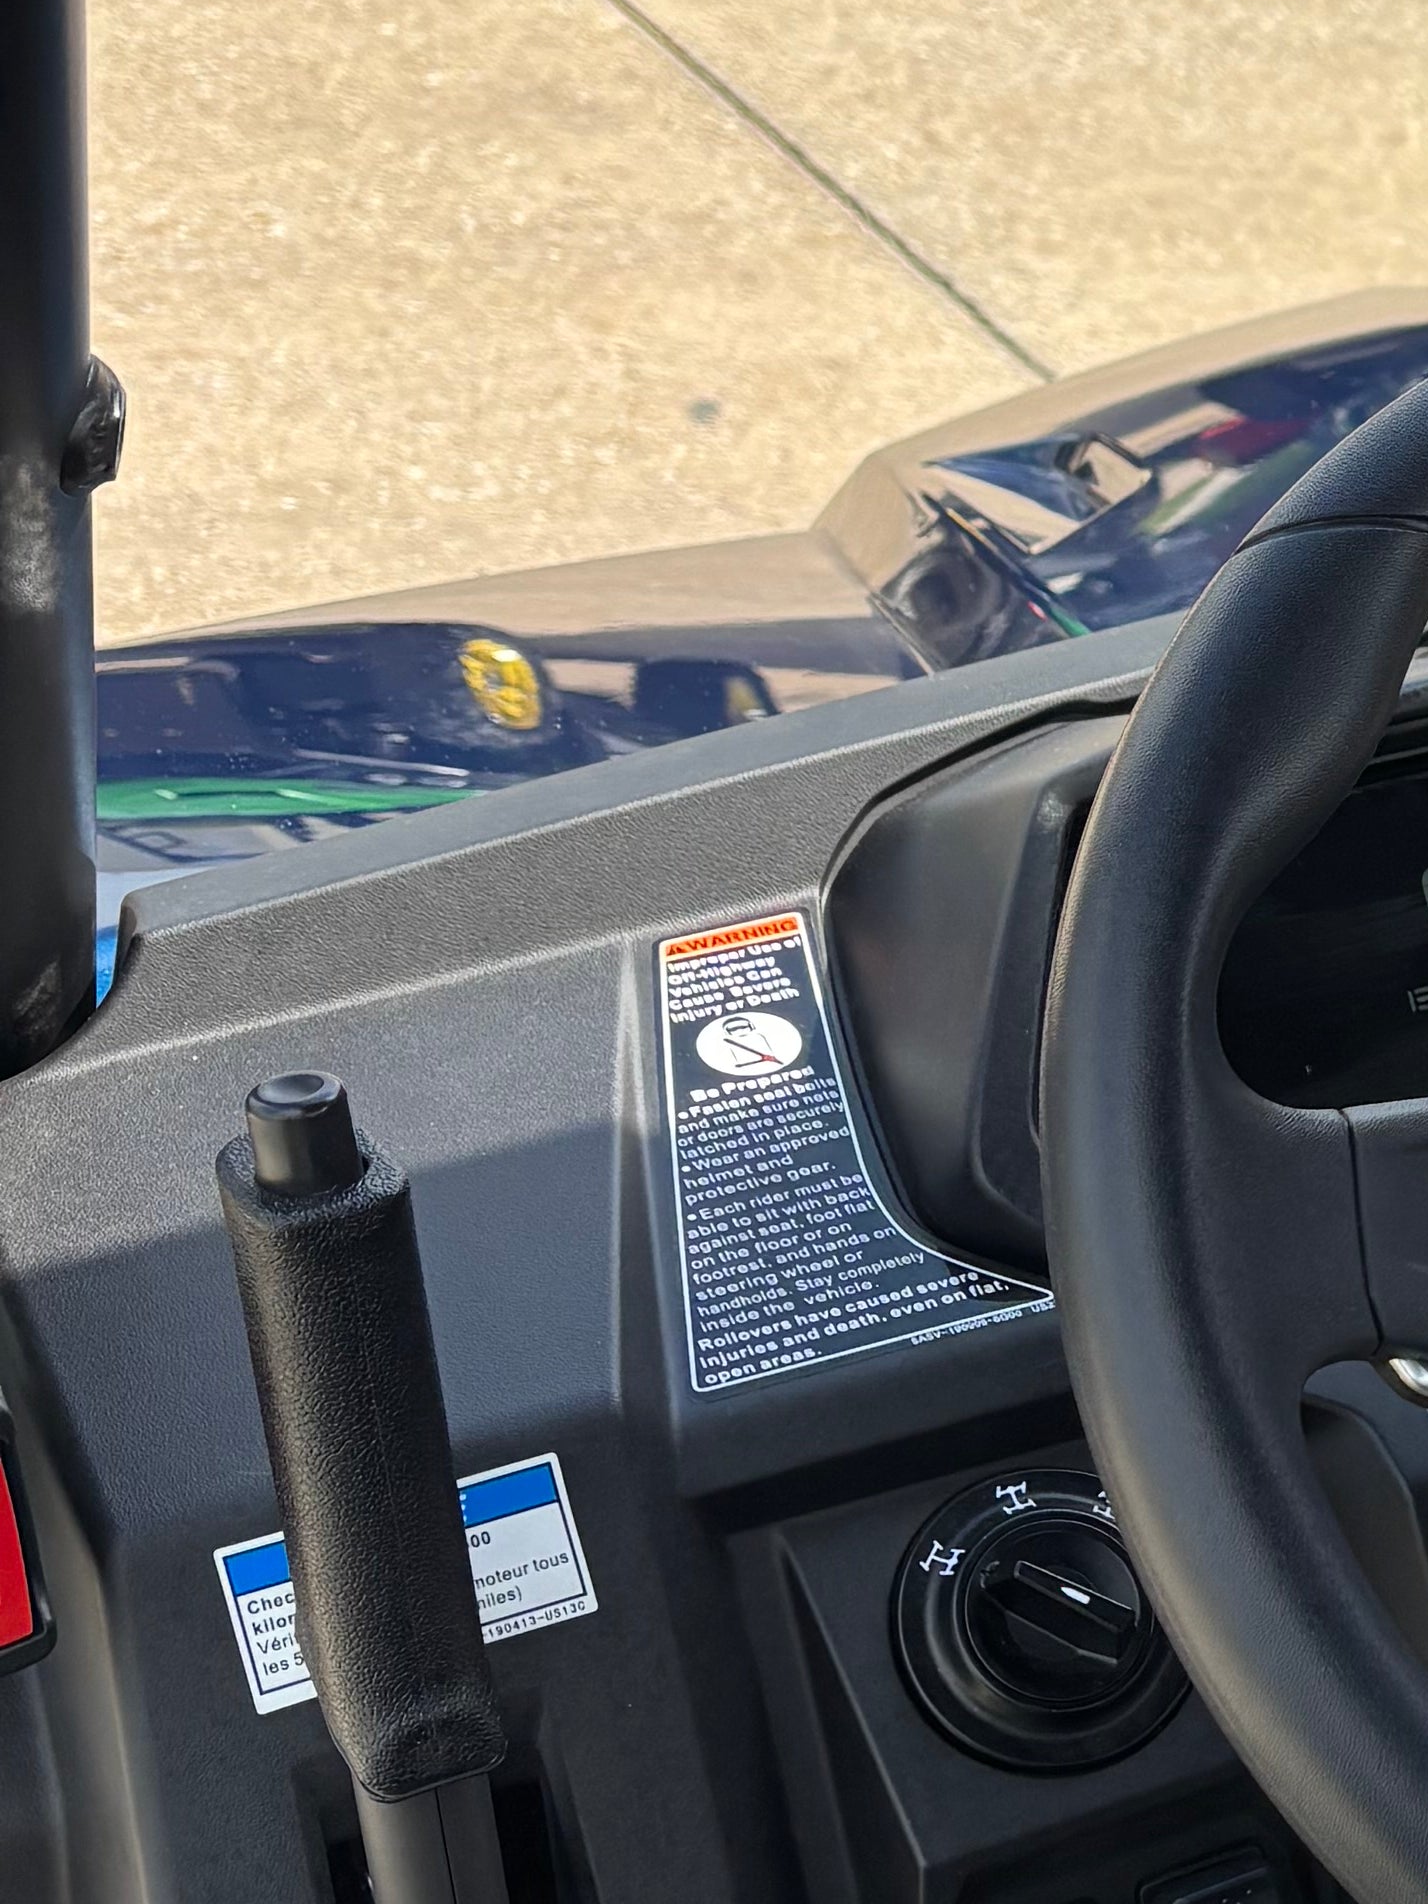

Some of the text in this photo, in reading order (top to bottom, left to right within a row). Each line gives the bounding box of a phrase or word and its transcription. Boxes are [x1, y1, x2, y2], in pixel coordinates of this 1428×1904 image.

[692, 917, 798, 952] WARNING
[722, 1066, 814, 1095] Prepared
[687, 1186, 871, 1239] able to sit with back
[699, 1174, 863, 1220] Each rider must be
[688, 1229, 756, 1254] against
[805, 1208, 843, 1224] foot
[844, 1199, 875, 1215] flat
[691, 1222, 852, 1270] on the floor or on
[775, 1246, 811, 1264] and
[812, 1233, 870, 1255] hands
[873, 1226, 897, 1240] on
[696, 1250, 863, 1301] steering wheel or
[697, 1252, 924, 1317] handholds. Stay completely
[698, 1272, 979, 1351] Rollovers have caused severe
[700, 1281, 879, 1333] inside the vehicle.
[782, 1327, 820, 1347] and
[704, 1348, 822, 1387] open areas.
[532, 1551, 570, 1574] tous
[246, 1593, 296, 1614] Chec
[262, 1659, 290, 1676] les
